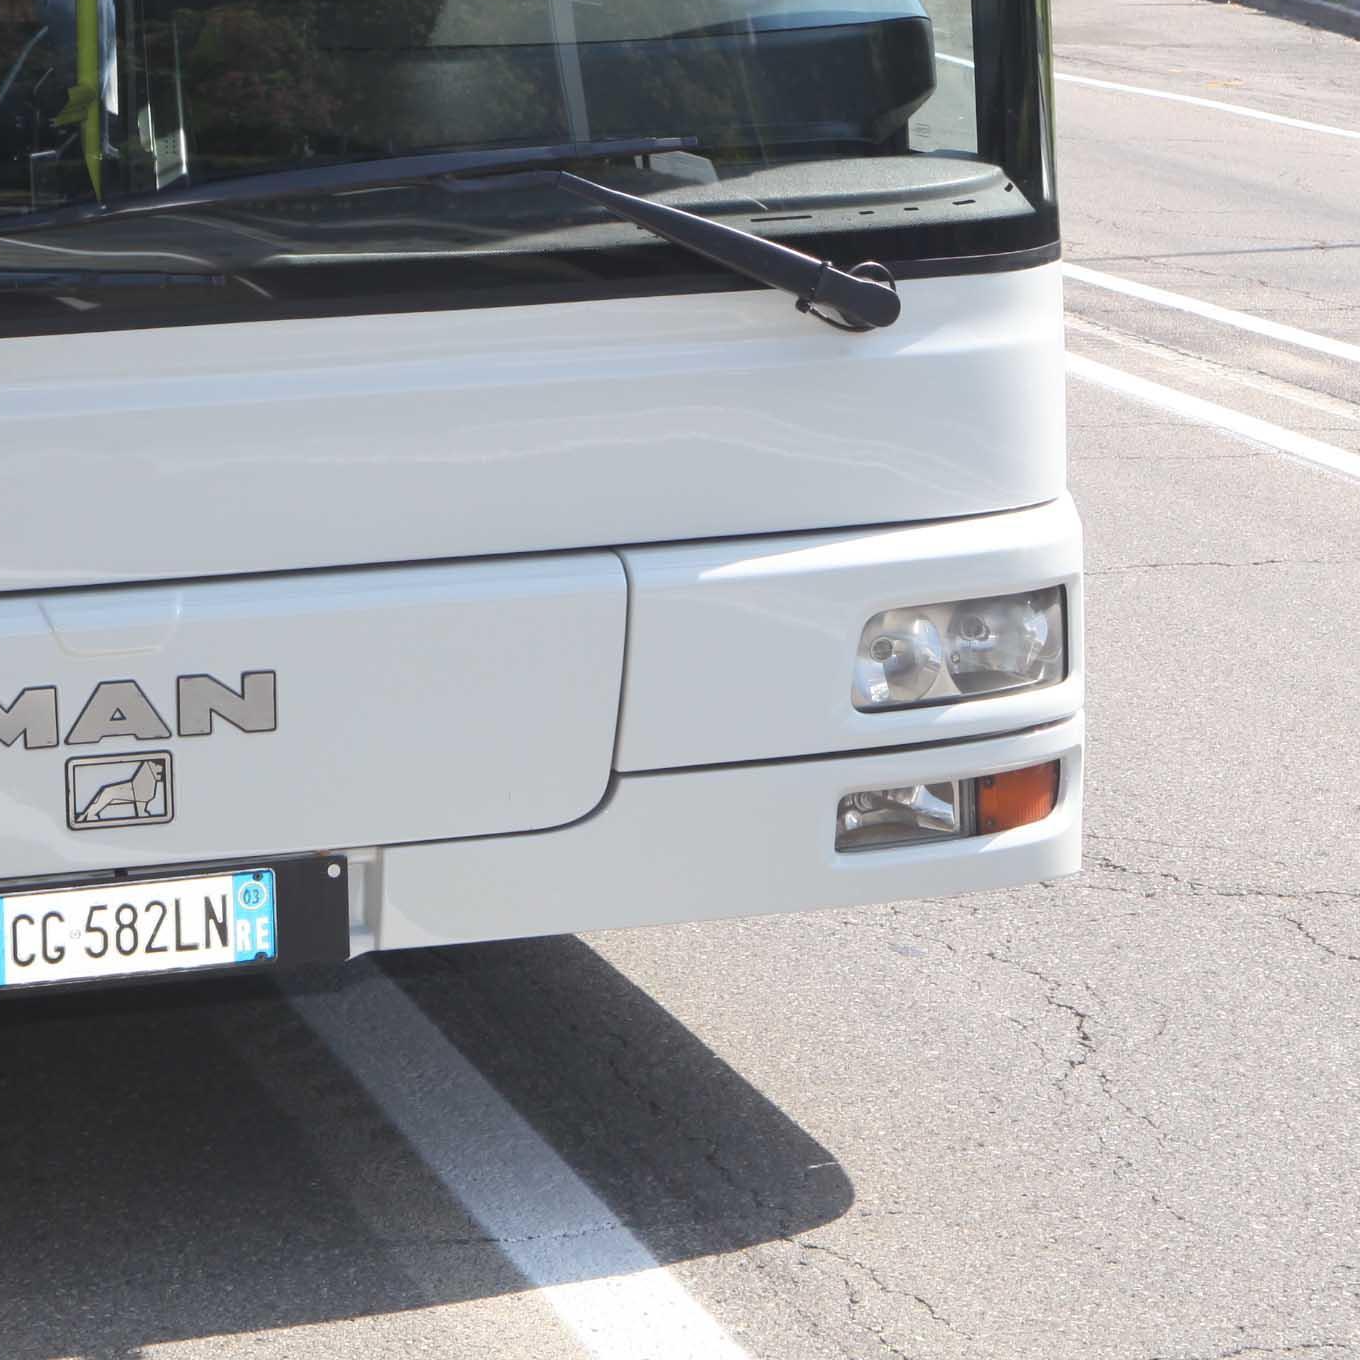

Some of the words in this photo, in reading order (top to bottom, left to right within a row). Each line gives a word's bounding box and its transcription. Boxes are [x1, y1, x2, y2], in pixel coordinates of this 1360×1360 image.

[11, 910, 66, 968] CG
[84, 894, 229, 959] 582LN
[236, 916, 271, 954] RE
